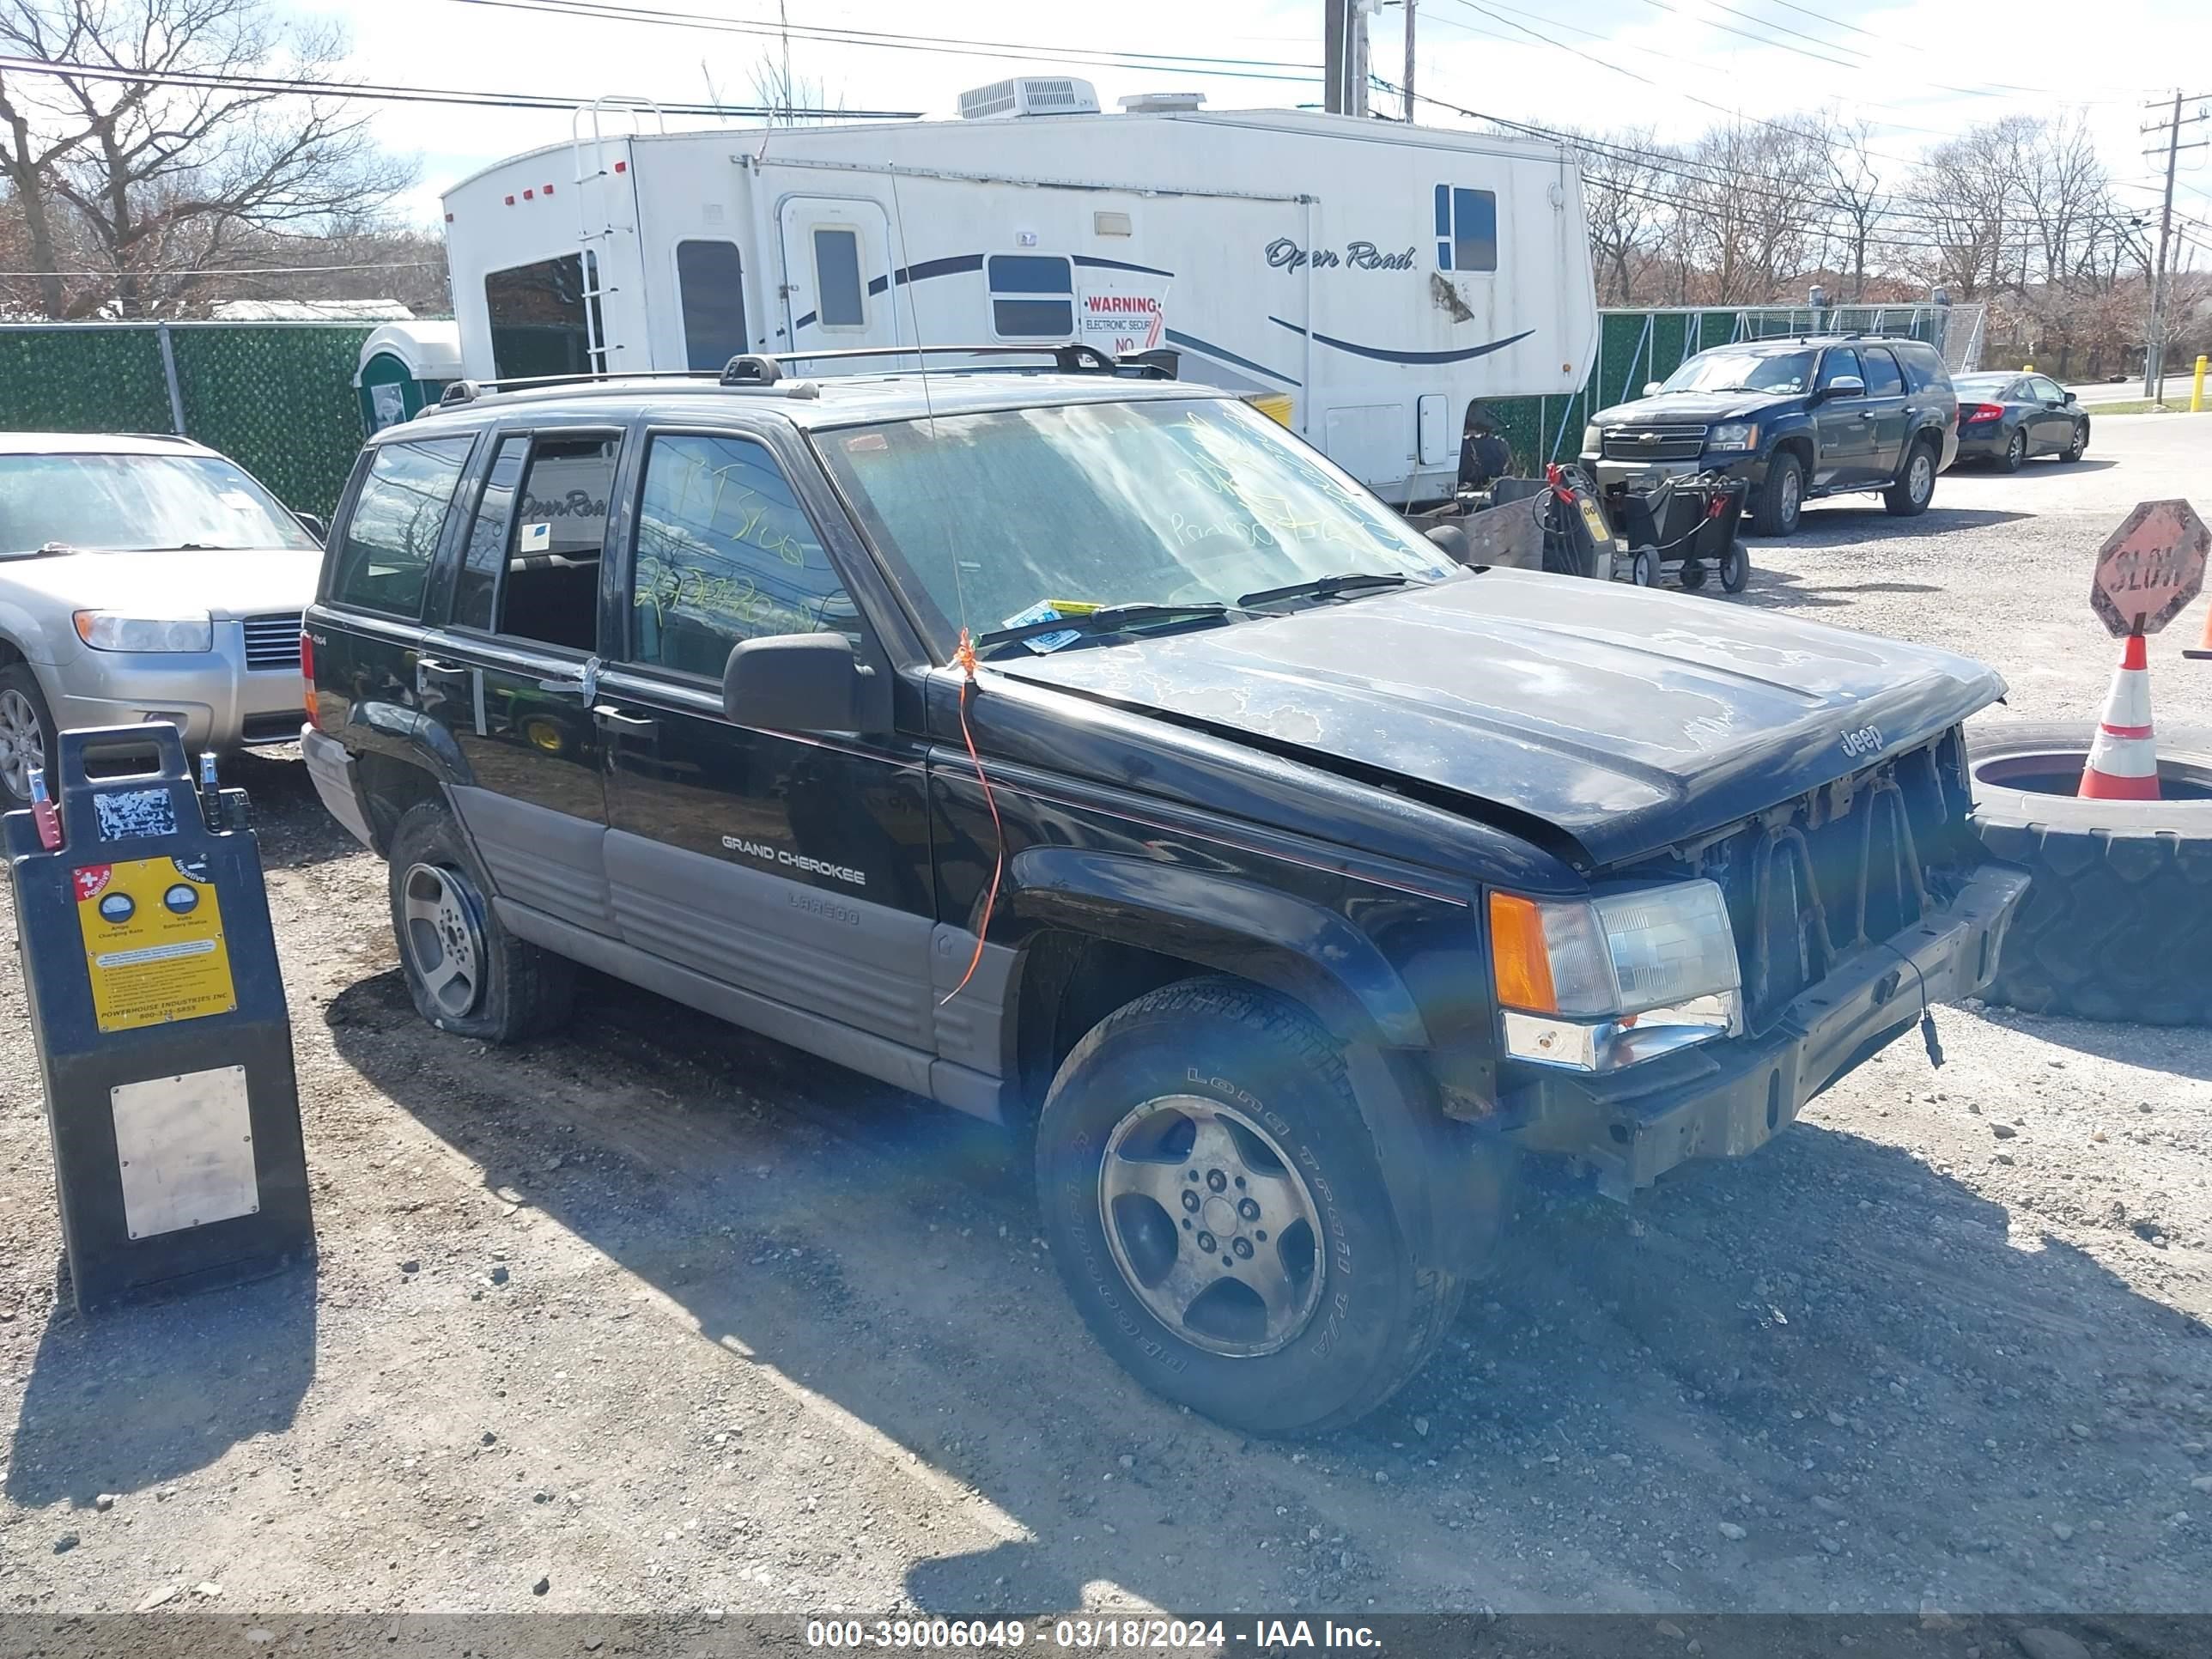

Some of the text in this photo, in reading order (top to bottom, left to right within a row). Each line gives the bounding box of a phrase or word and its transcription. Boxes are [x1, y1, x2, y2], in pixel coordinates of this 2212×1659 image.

[1265, 237, 1416, 275] Open Road
[1088, 296, 1157, 313] WARNING
[1086, 319, 1127, 330] ELECTRONIC
[1115, 337, 1133, 353] NO
[565, 489, 608, 518] Roa
[1839, 725, 1883, 757] Jeep
[174, 859, 206, 883] Negative
[721, 835, 866, 885] GRAND CHEROKEE
[83, 870, 111, 898] Positive
[787, 892, 860, 926] LAREDO
[101, 1001, 160, 1018] POWERHOUSE
[161, 995, 212, 1010] INDUSTRIES
[1188, 1067, 1291, 1135] Long
[1312, 1293, 1349, 1358] T/A
